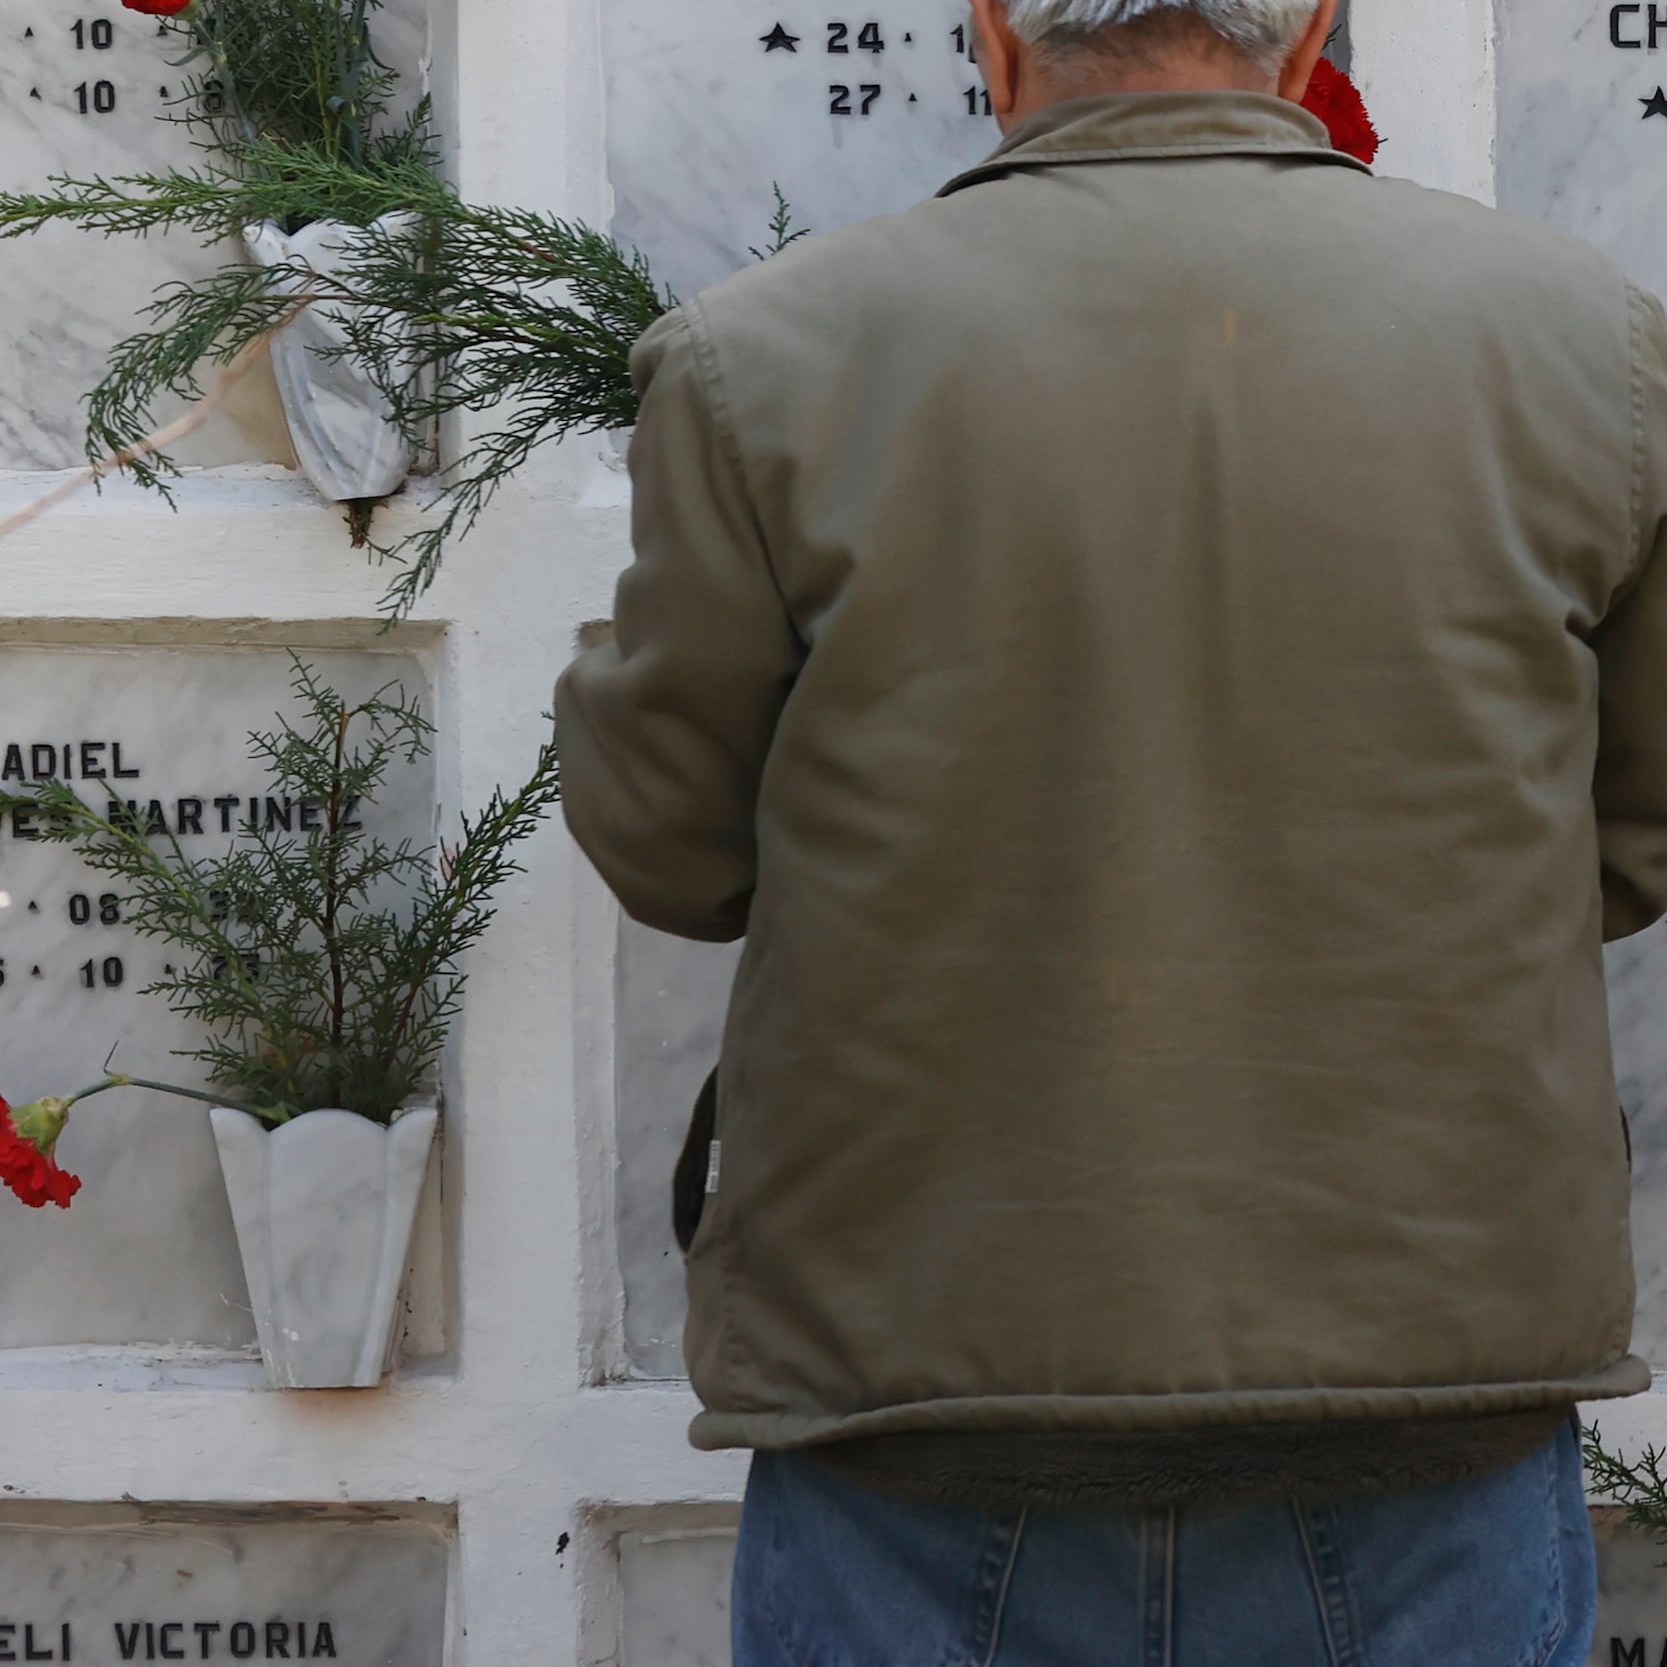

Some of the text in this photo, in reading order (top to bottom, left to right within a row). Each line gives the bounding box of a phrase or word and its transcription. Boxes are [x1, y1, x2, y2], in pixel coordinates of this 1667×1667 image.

[70, 18, 113, 50] 10
[826, 22, 885, 54] 24
[74, 79, 116, 115] 10
[829, 84, 881, 116] 27
[2, 741, 140, 781] ADIEL
[69, 893, 120, 926] 08
[80, 956, 124, 988] 10
[113, 1621, 338, 1660] VICTORIA
